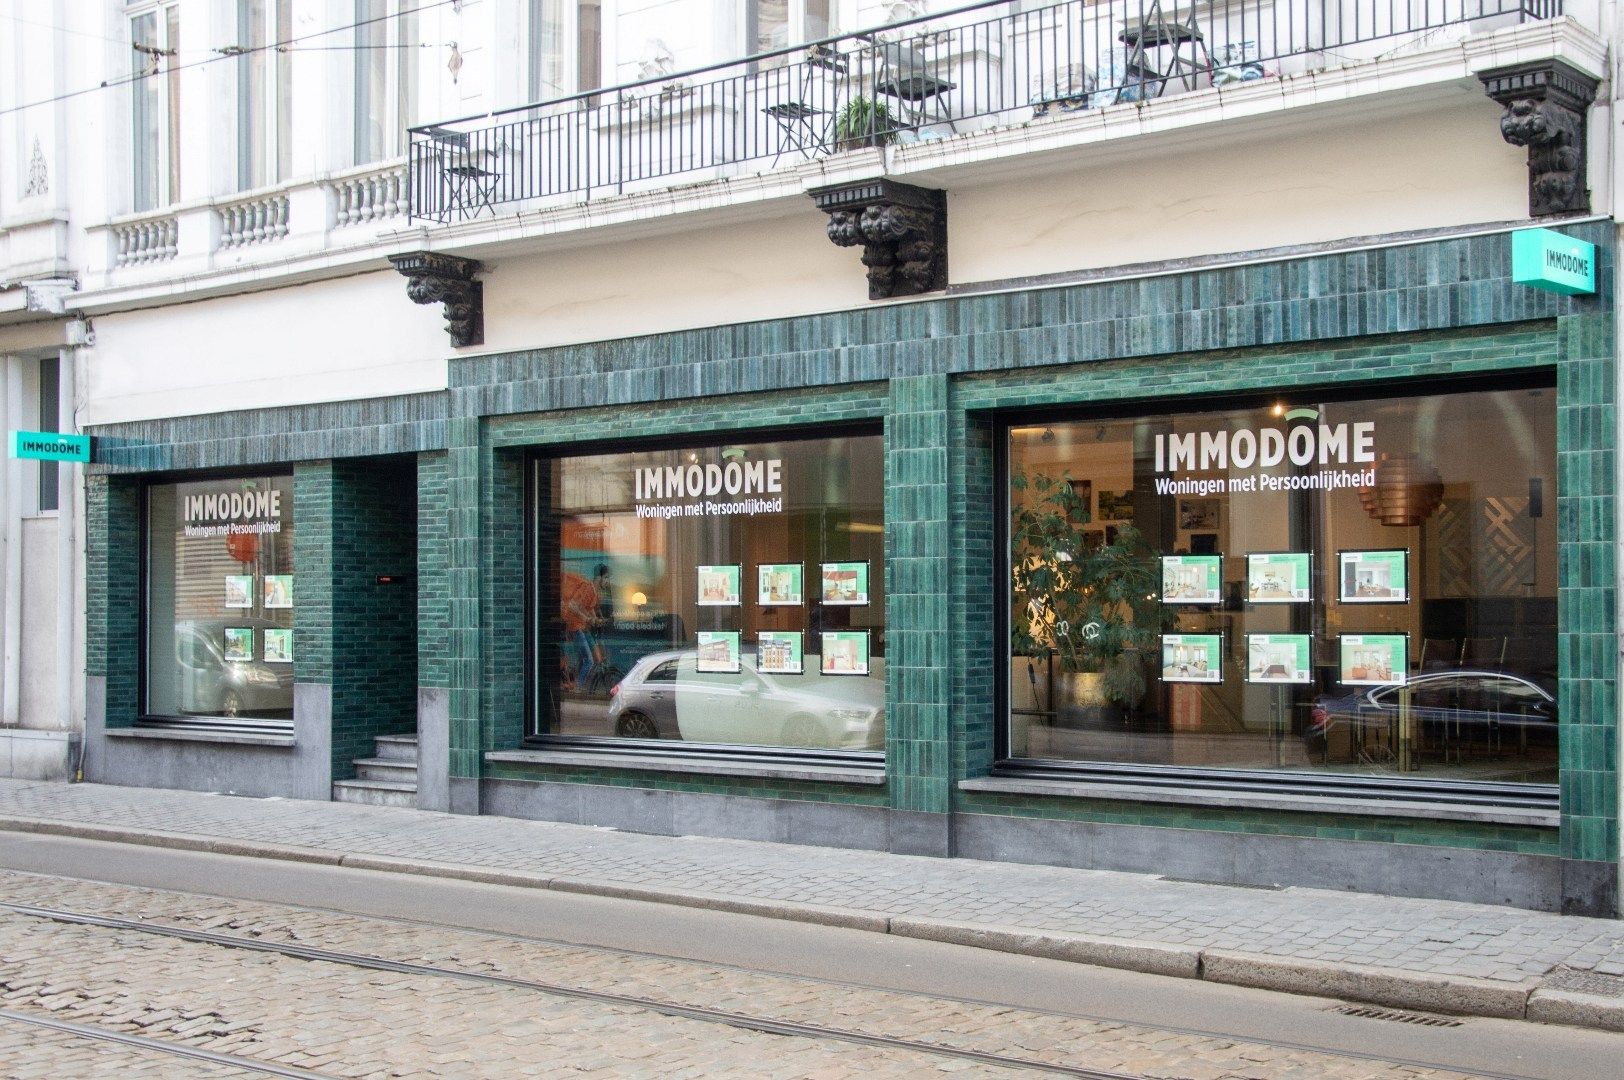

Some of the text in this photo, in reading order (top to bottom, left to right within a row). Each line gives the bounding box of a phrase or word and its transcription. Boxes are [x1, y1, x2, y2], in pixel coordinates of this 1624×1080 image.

[1546, 249, 1589, 277] IMMODOME
[23, 441, 82, 455] IMMODOME
[1154, 421, 1375, 472] IMMODOME
[635, 459, 782, 499] IMMODOME
[1155, 469, 1375, 497] Woningen met Persoonlijkheid
[184, 489, 281, 521] IMMODOME
[635, 498, 782, 520] Woningen met Persoonlijkheid
[184, 521, 281, 538] Woningen met Persoonlijkheid
